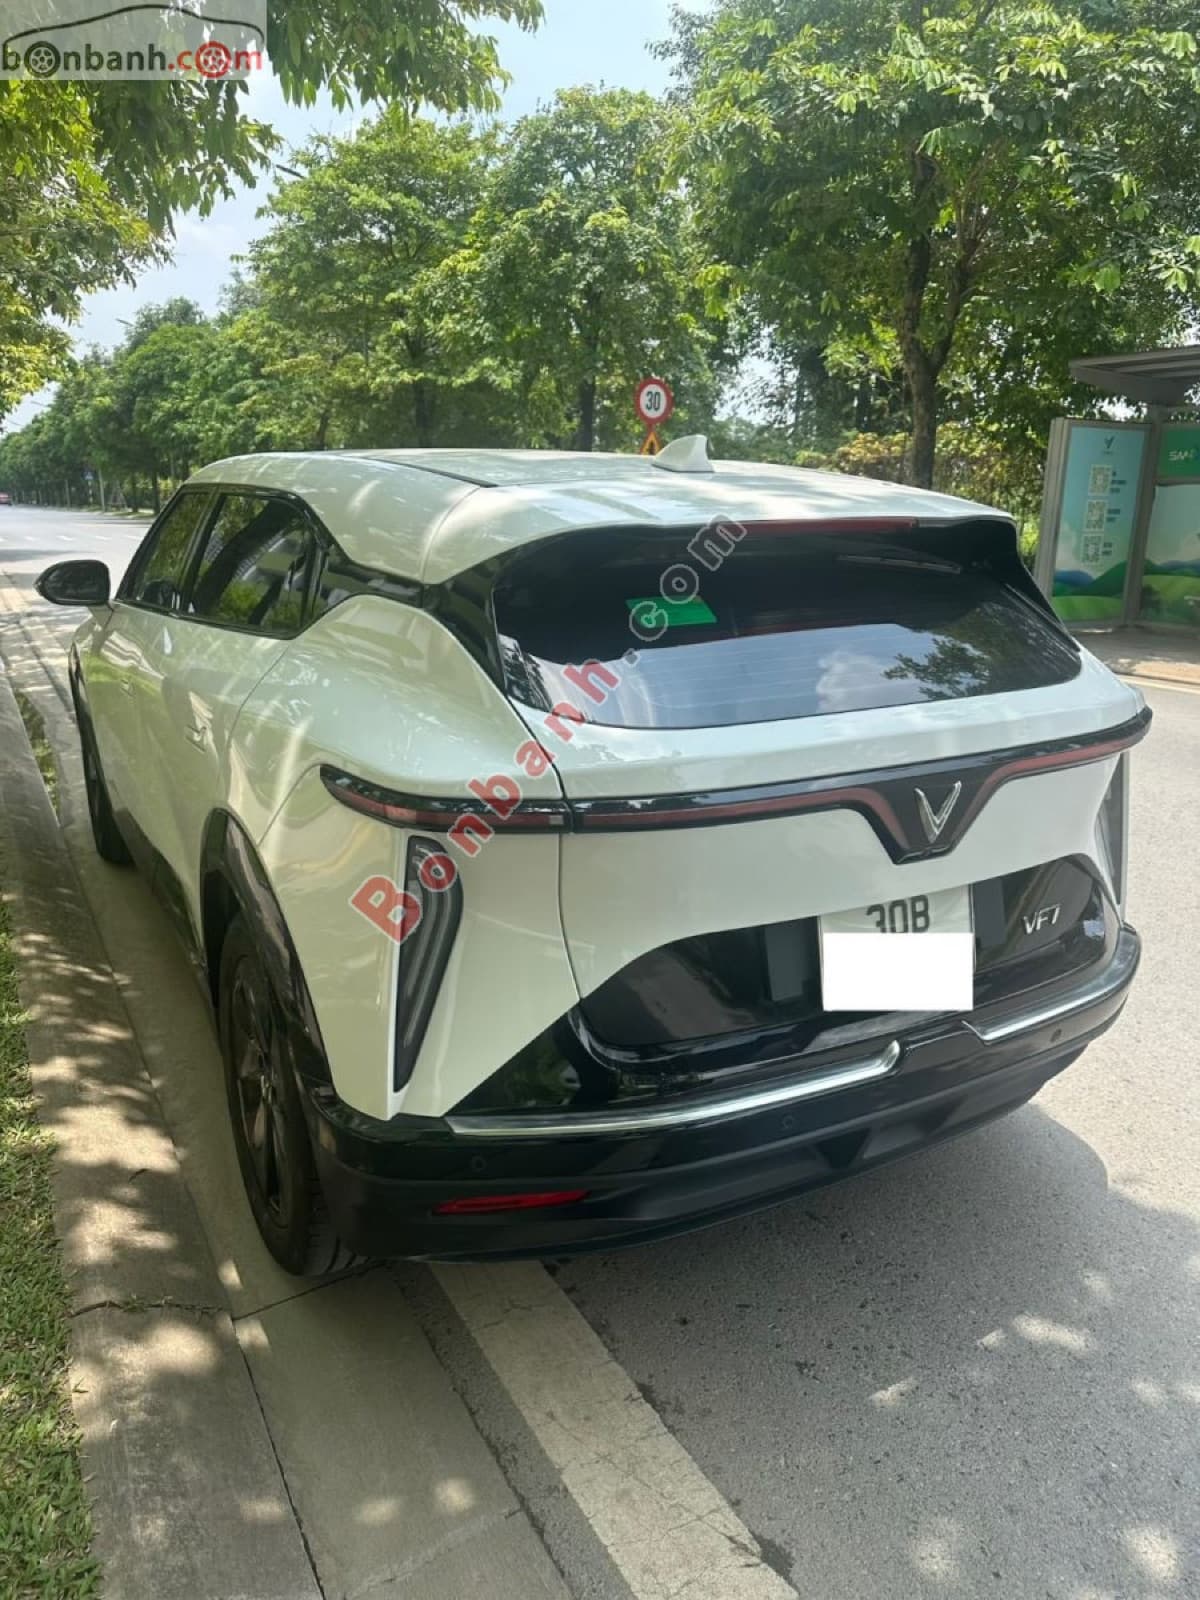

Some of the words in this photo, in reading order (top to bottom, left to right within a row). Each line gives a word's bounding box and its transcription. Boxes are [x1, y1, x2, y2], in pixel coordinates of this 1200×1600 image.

[646, 391, 661, 411] 30
[865, 894, 930, 933] 30B
[1023, 904, 1060, 934] VF7
